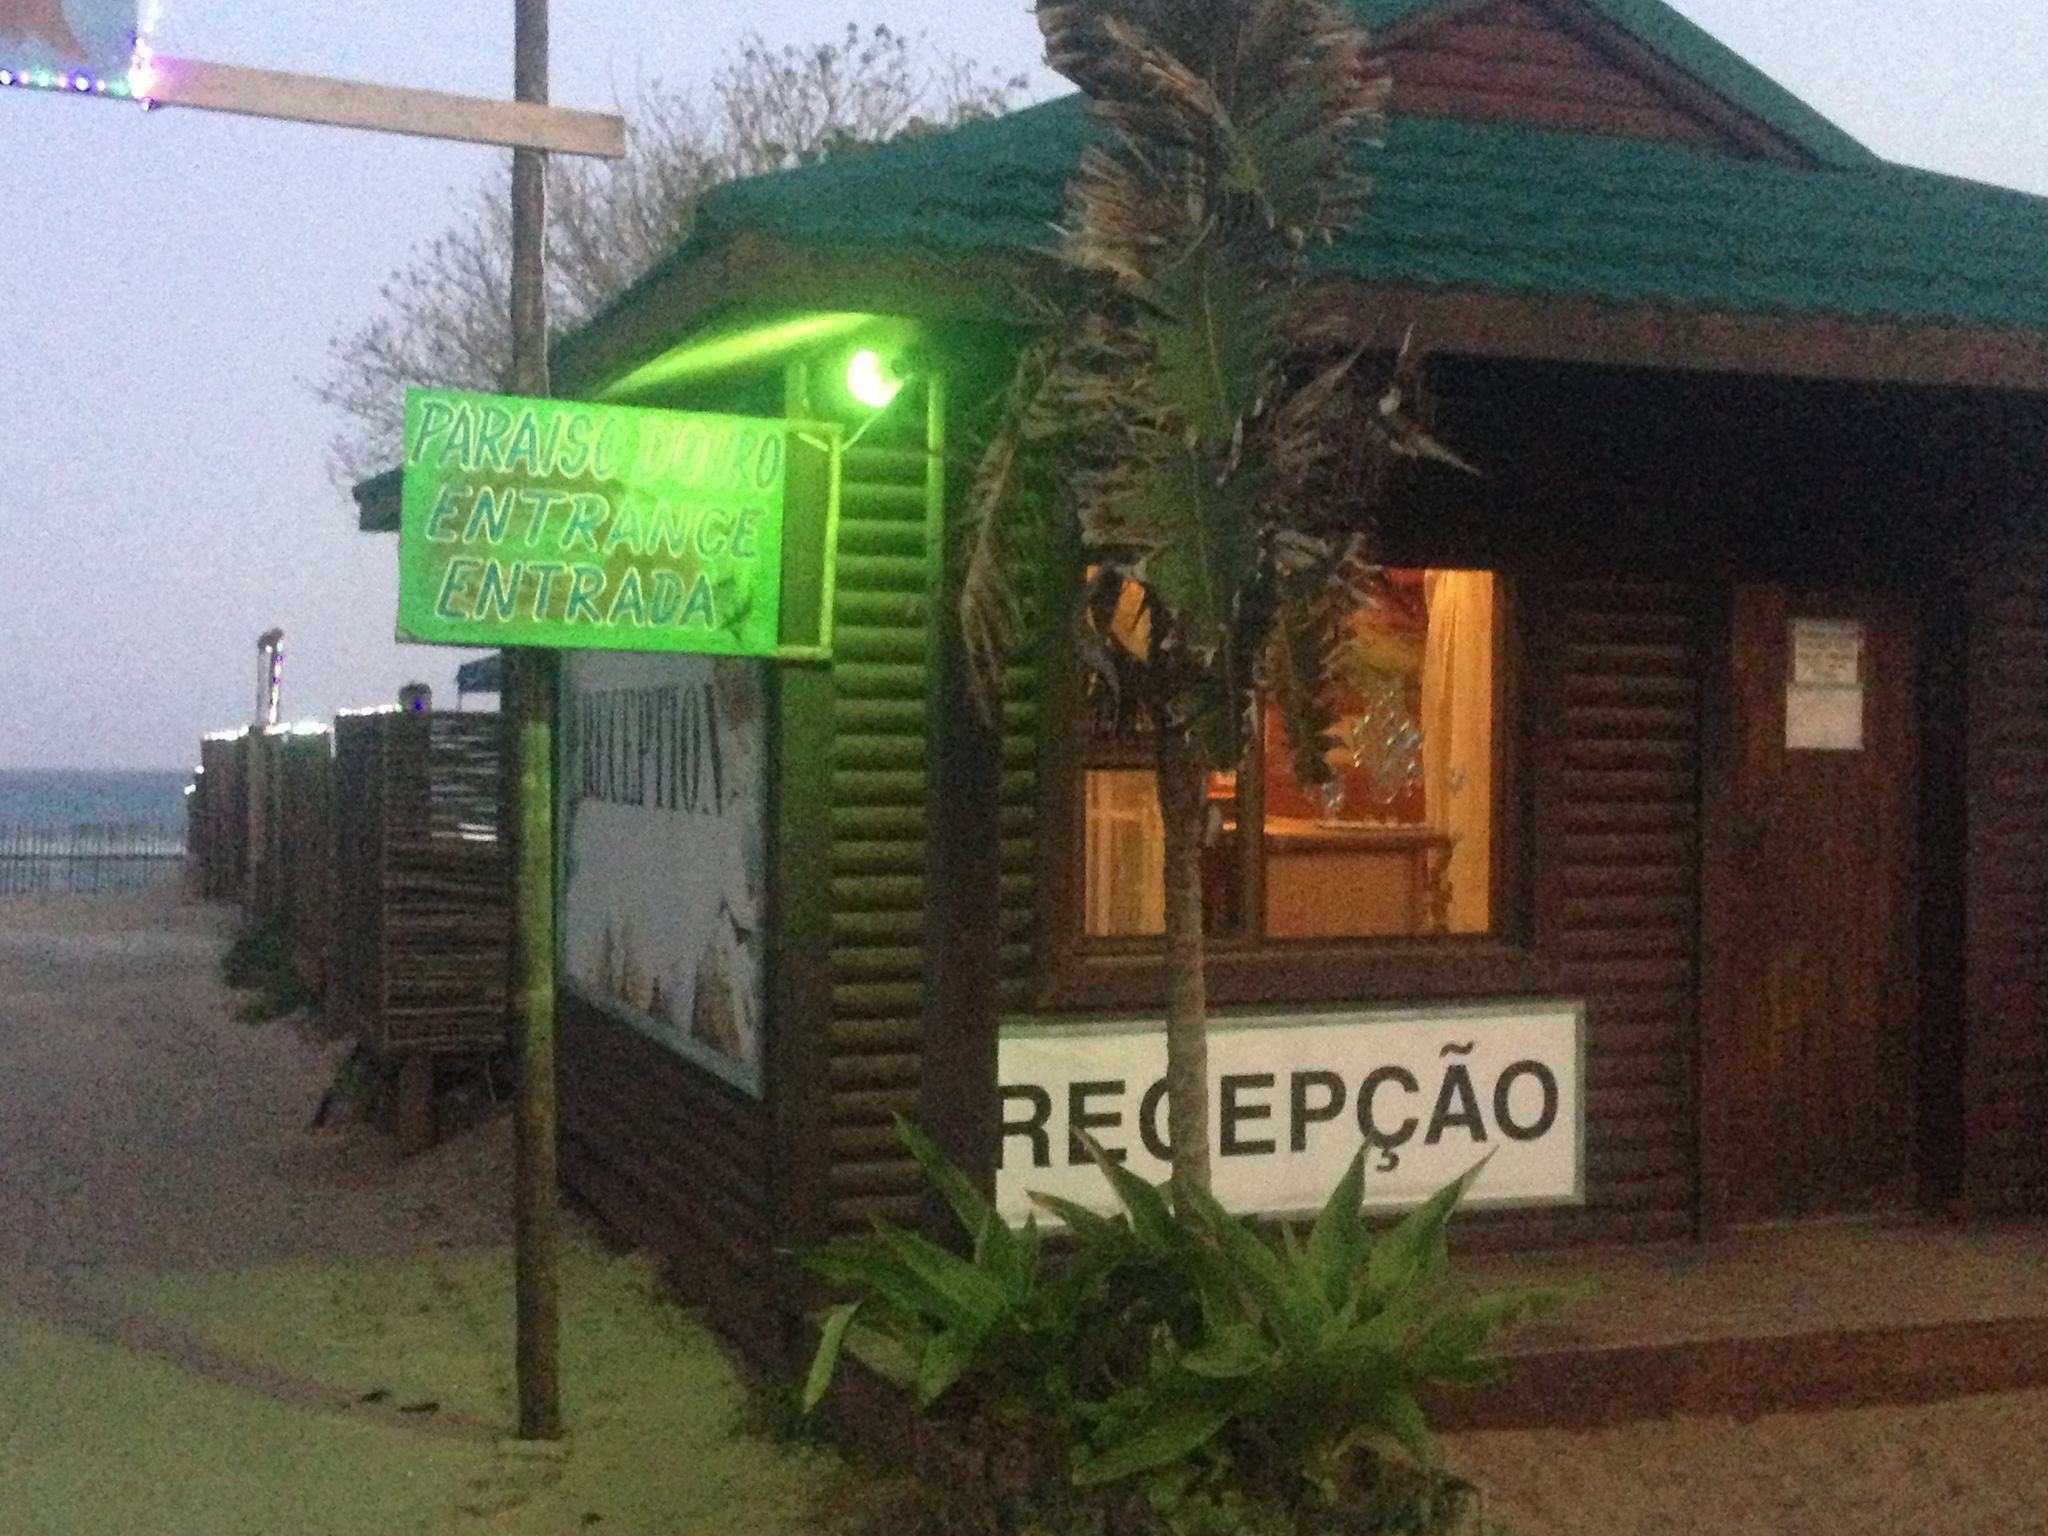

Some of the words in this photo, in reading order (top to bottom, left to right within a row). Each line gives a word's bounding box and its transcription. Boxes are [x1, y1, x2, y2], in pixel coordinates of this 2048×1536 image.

[411, 399, 628, 482] PARAISO
[424, 485, 768, 559] ENTRANCE
[434, 555, 720, 632] ENTRADA
